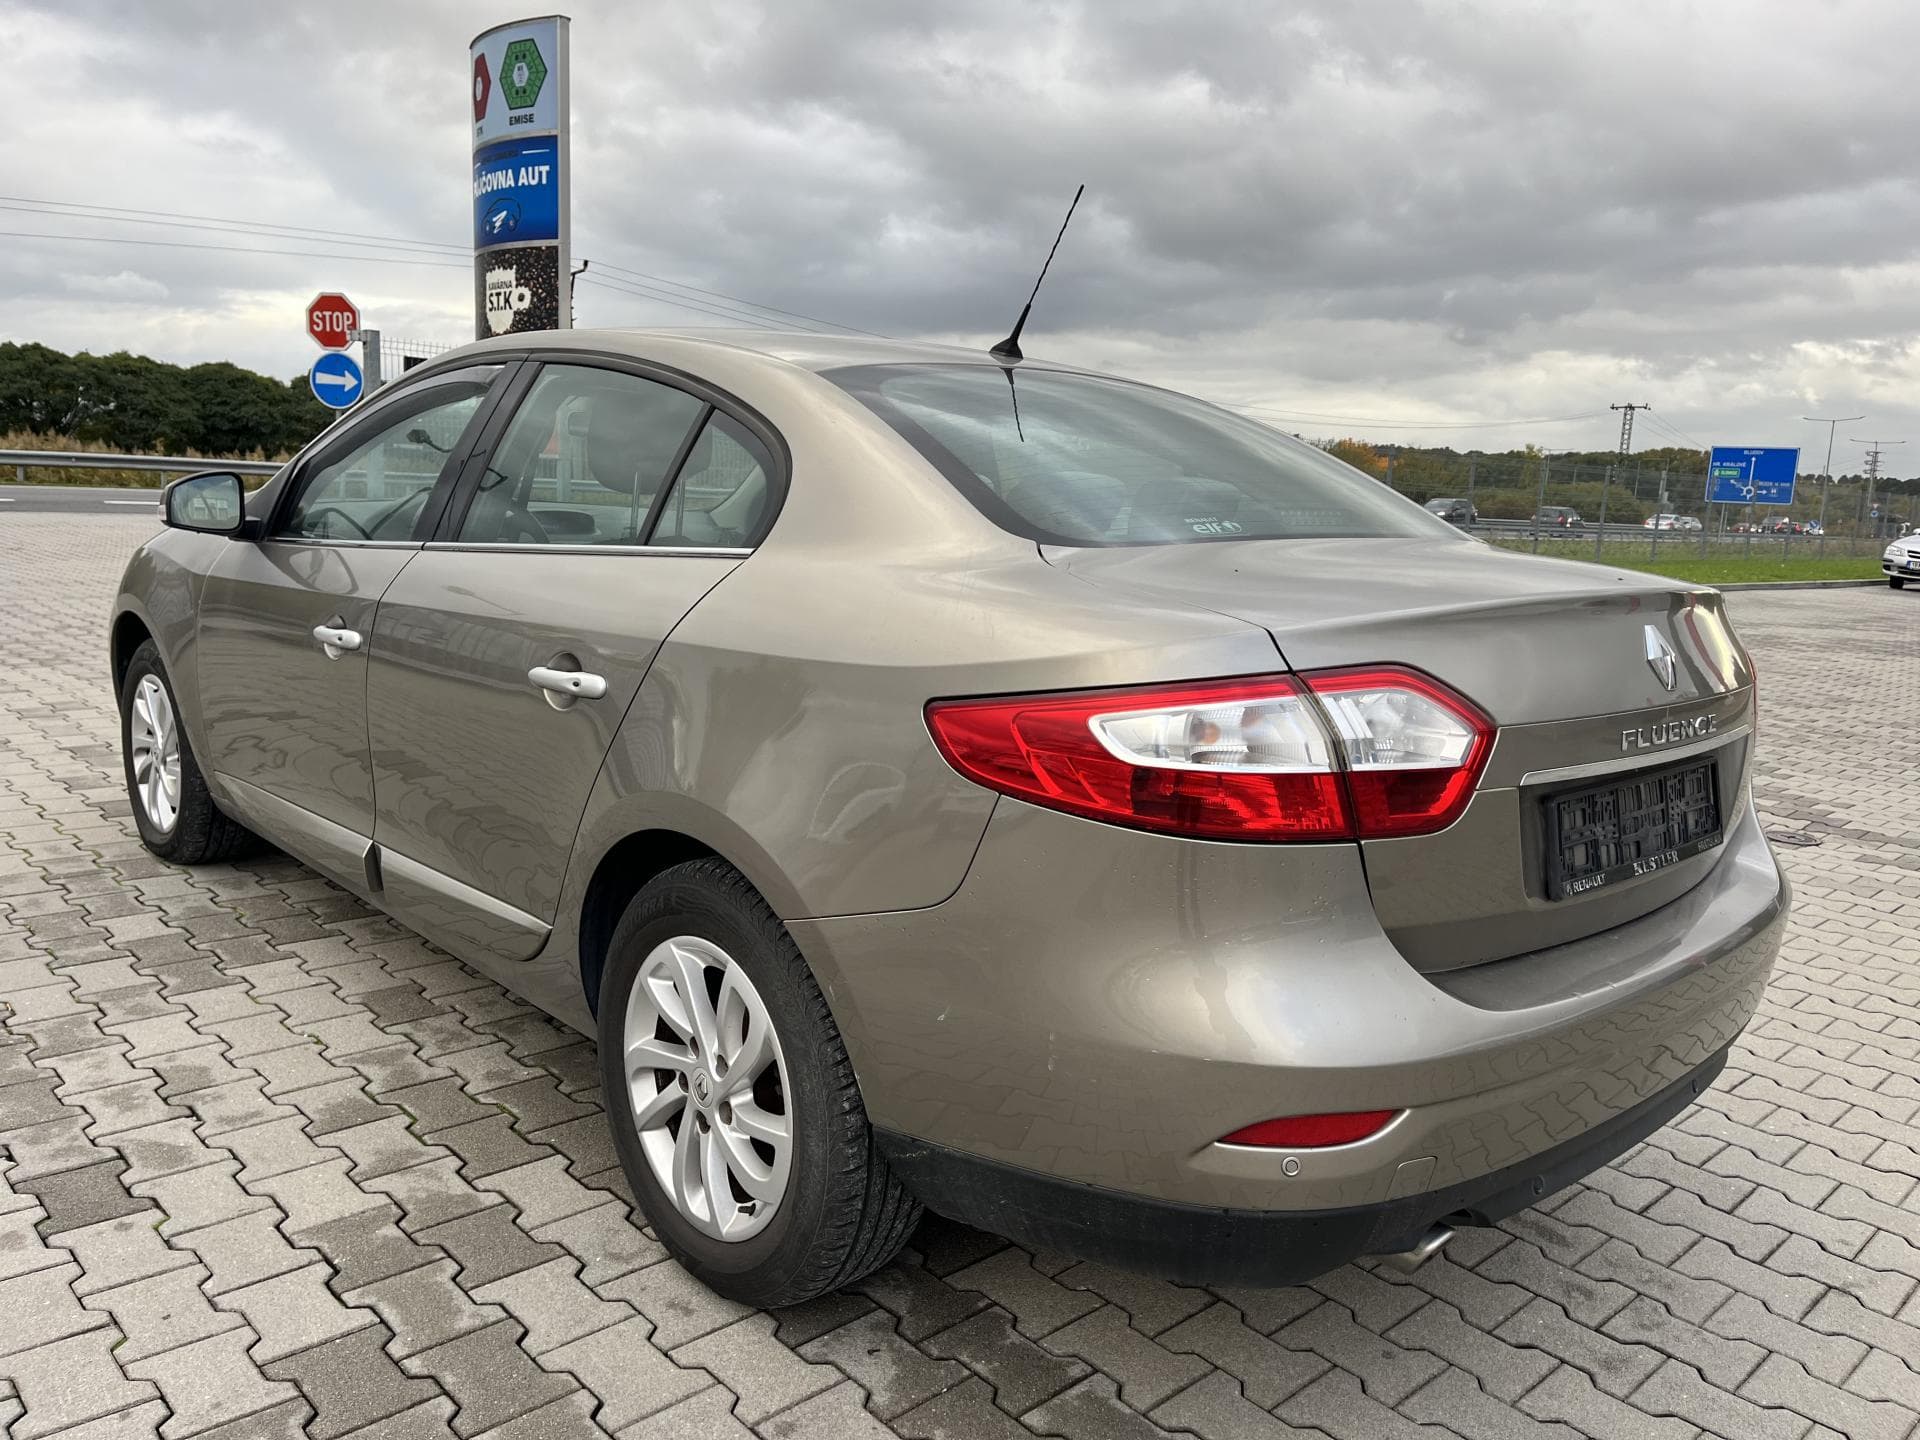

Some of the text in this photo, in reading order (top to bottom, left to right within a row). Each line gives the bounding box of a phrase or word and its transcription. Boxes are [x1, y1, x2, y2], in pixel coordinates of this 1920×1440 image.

[509, 113, 535, 126] EMISE
[518, 165, 550, 187] AUT
[312, 310, 353, 332] STOP
[1621, 713, 1717, 751] FLUENCE
[1573, 873, 1607, 893] RENAULT
